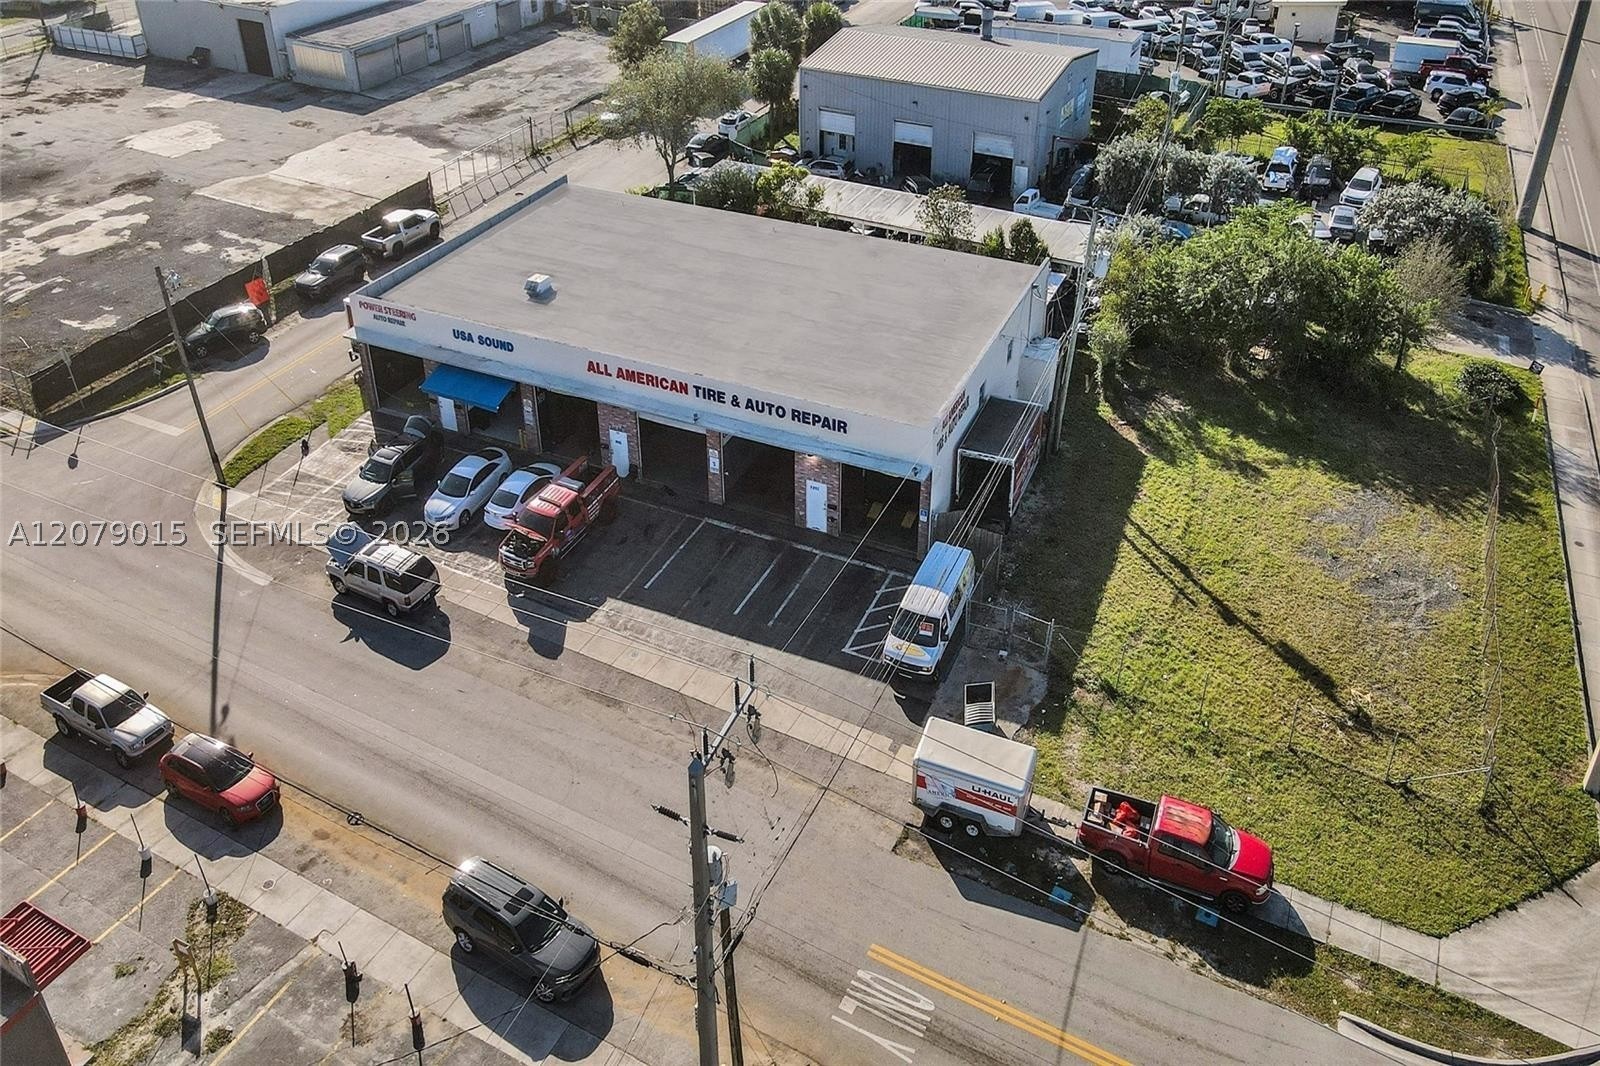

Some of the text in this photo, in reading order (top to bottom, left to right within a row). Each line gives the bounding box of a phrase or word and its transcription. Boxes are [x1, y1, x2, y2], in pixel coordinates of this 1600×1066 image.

[359, 300, 416, 321] POWER STEERING
[373, 313, 406, 327] AUTO REPAIR
[452, 328, 514, 352] USA SOUND
[586, 360, 848, 434] ALL AMERICAN TIRE & AUTO REPAIR
[971, 785, 1013, 803] U-HAUL
[831, 969, 936, 1064] ONLY
